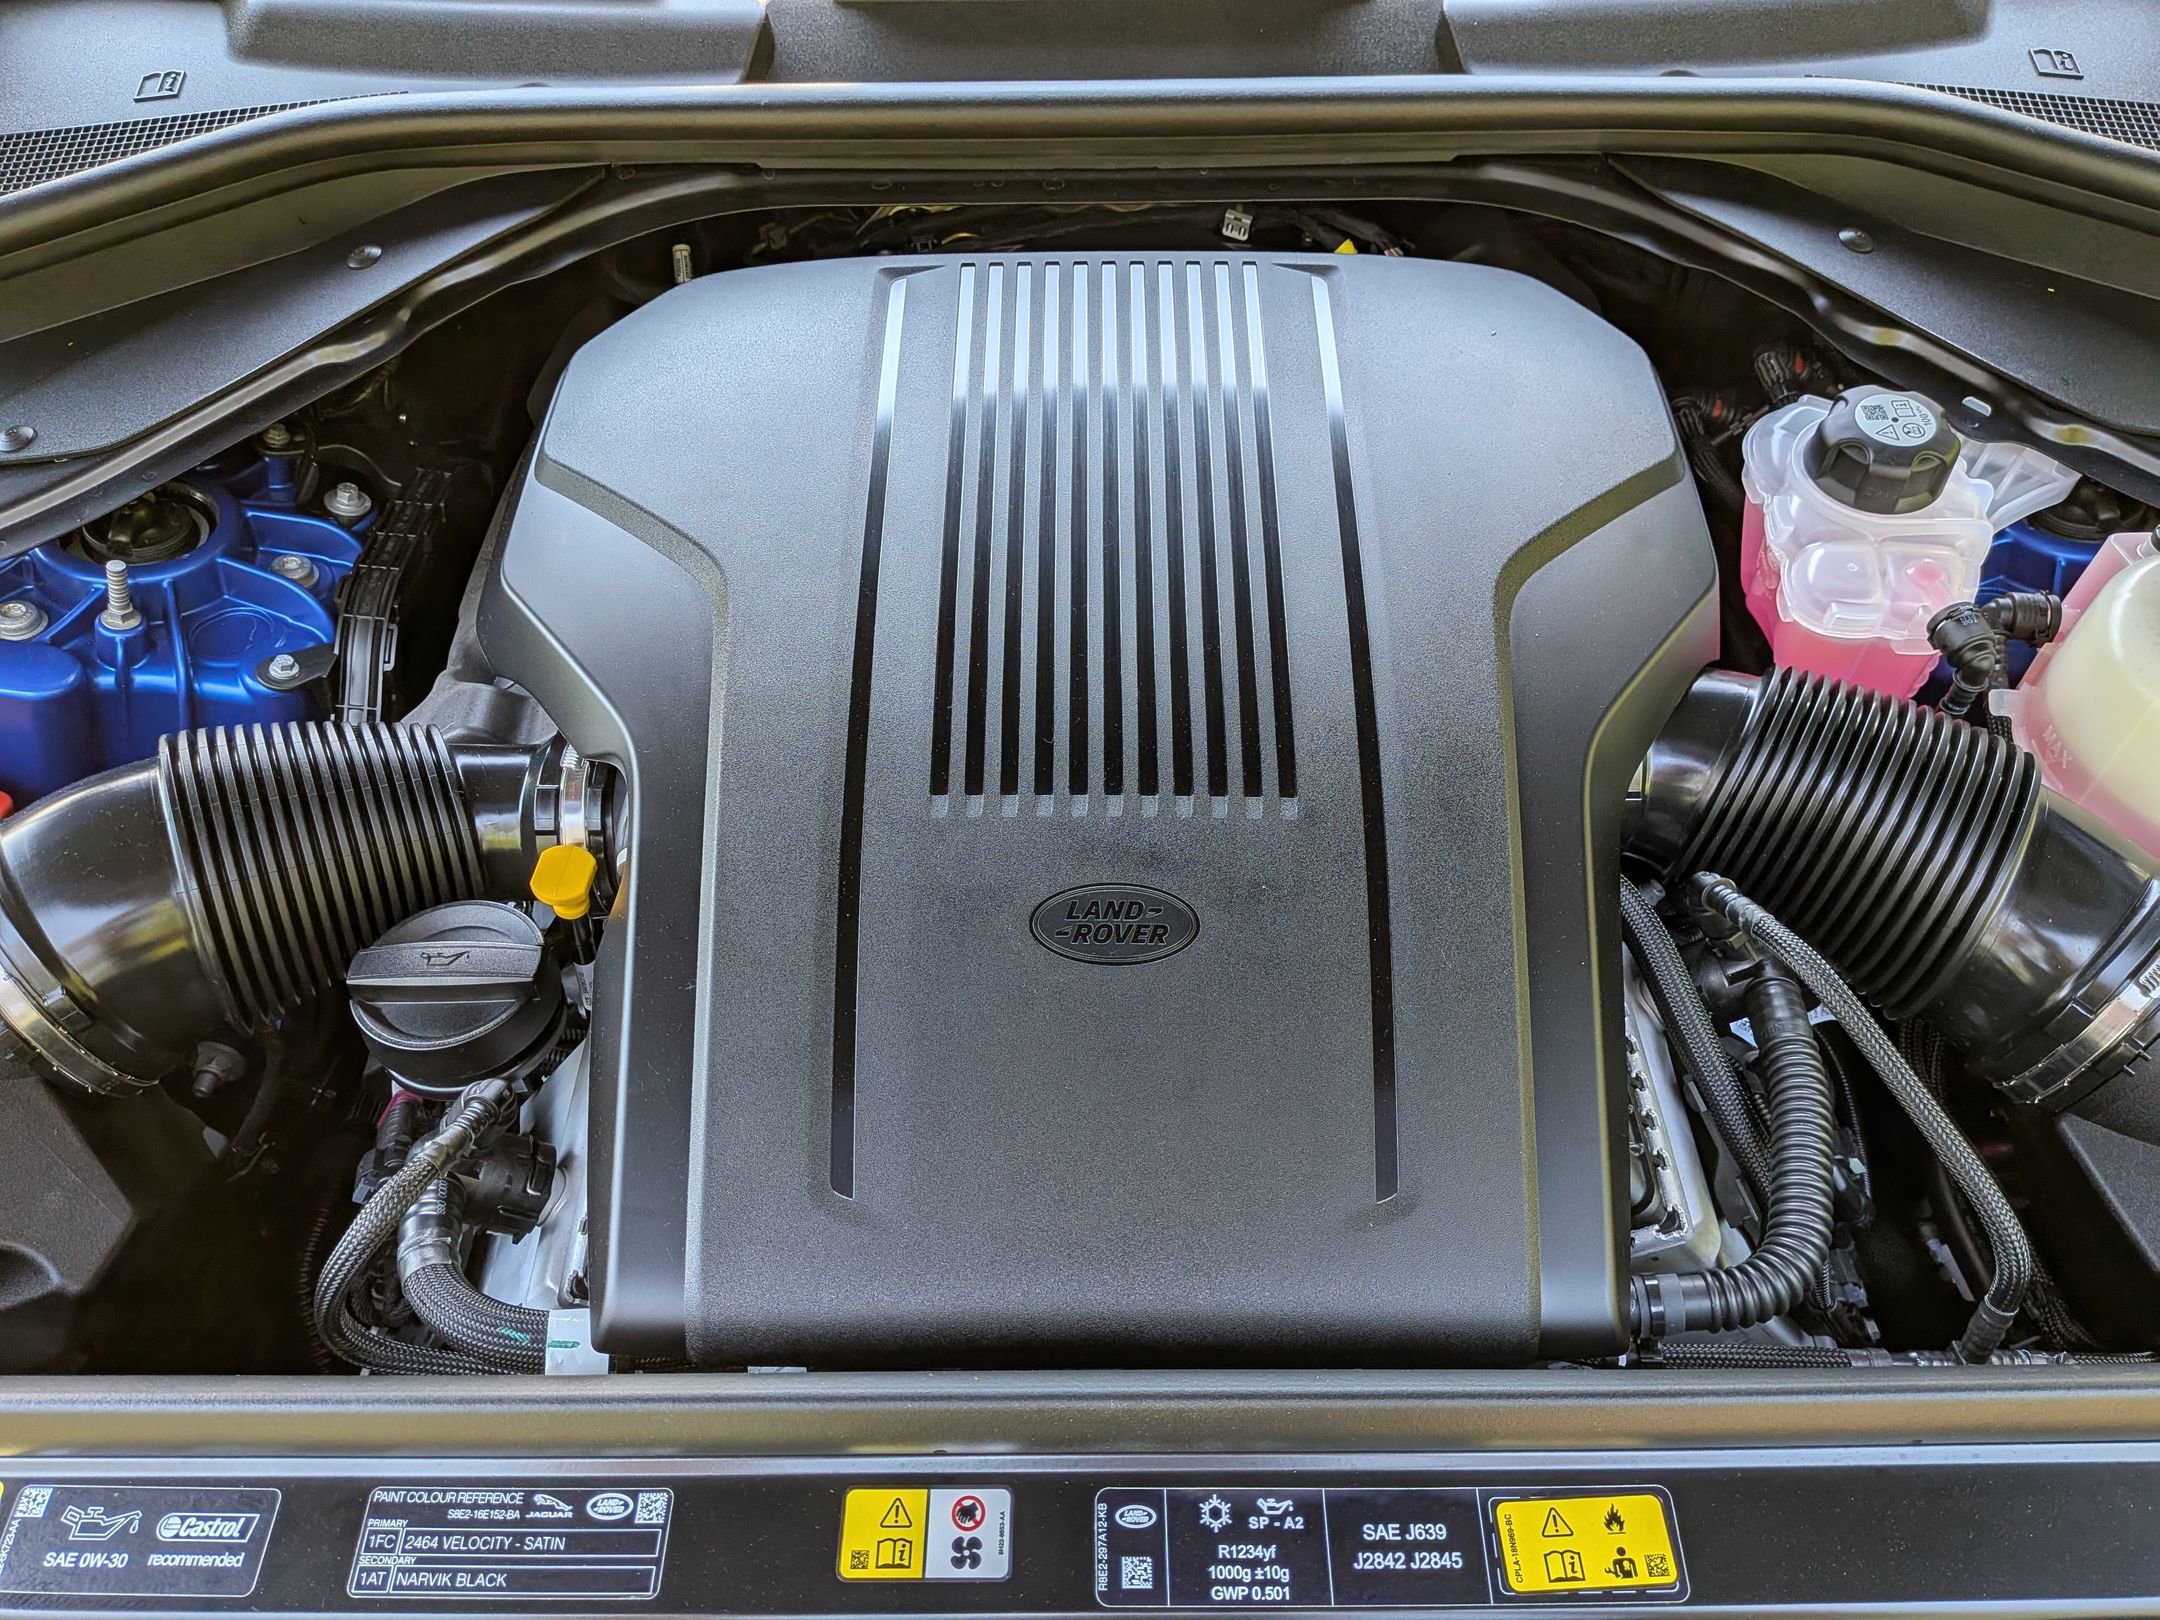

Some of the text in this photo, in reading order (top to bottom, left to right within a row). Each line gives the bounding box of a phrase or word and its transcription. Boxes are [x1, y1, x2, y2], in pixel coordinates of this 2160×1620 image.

[2042, 725, 2072, 769] MAX
[373, 1491, 525, 1505] PAINT COLOUR REFERENCE
[525, 1511, 574, 1519] JAGUAR
[1248, 1516, 1270, 1530] SP
[1283, 1516, 1305, 1530] A2
[179, 1517, 247, 1538] Castrol
[367, 1519, 409, 1528] PRIMARY
[1362, 1523, 1447, 1541] SAE J639
[368, 1534, 397, 1549] 1FC
[404, 1535, 439, 1550] 2464
[442, 1535, 513, 1551] VELOCITY
[523, 1536, 567, 1551] SATIN
[43, 1551, 129, 1569] SAE 0W-30
[147, 1551, 246, 1568] recommended
[358, 1555, 417, 1565] SECONDARY
[1217, 1544, 1277, 1562] R1234yf
[1352, 1552, 1463, 1570] J2842 J2845
[360, 1571, 388, 1586] 1AT
[395, 1572, 508, 1588] NARVIK BLACK
[1207, 1565, 1290, 1583] 1000g ±10g
[1210, 1585, 1290, 1601] GWP 0.501
